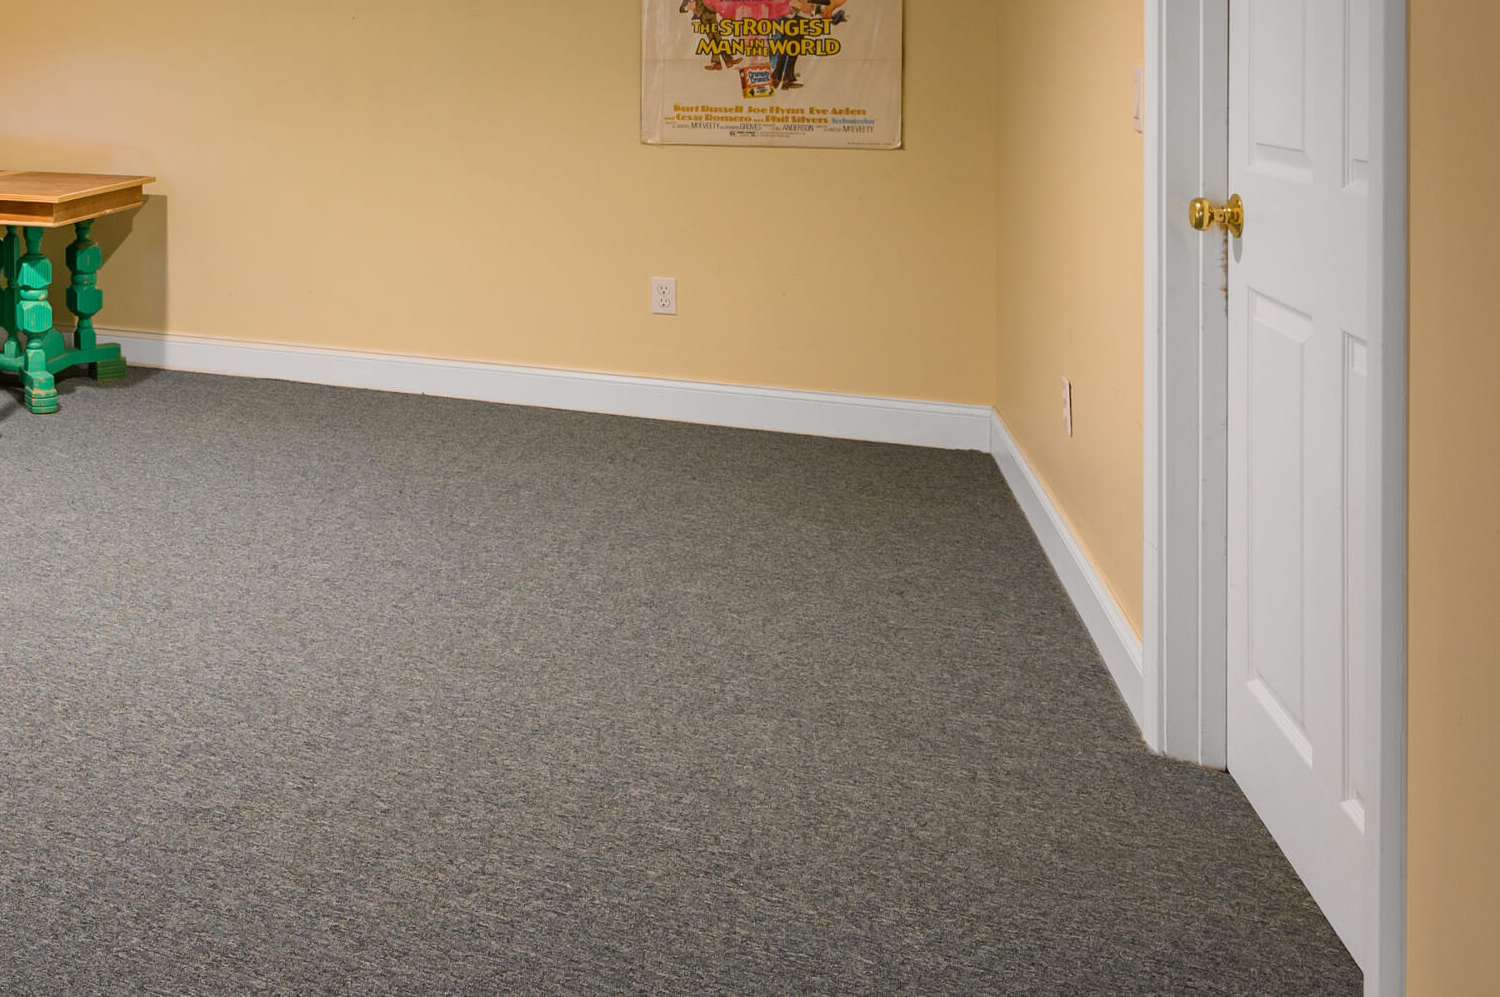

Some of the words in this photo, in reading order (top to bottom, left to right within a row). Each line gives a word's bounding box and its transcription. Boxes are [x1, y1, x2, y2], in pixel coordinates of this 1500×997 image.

[692, 22, 718, 34] THE
[718, 17, 832, 37] STRONGEST
[696, 38, 746, 55] MAN
[750, 38, 764, 48] IN
[768, 38, 841, 57] WORLD
[745, 46, 770, 57] THE
[769, 106, 804, 115] Flynn
[765, 115, 789, 123] Phil
[791, 116, 828, 124] Silvers
